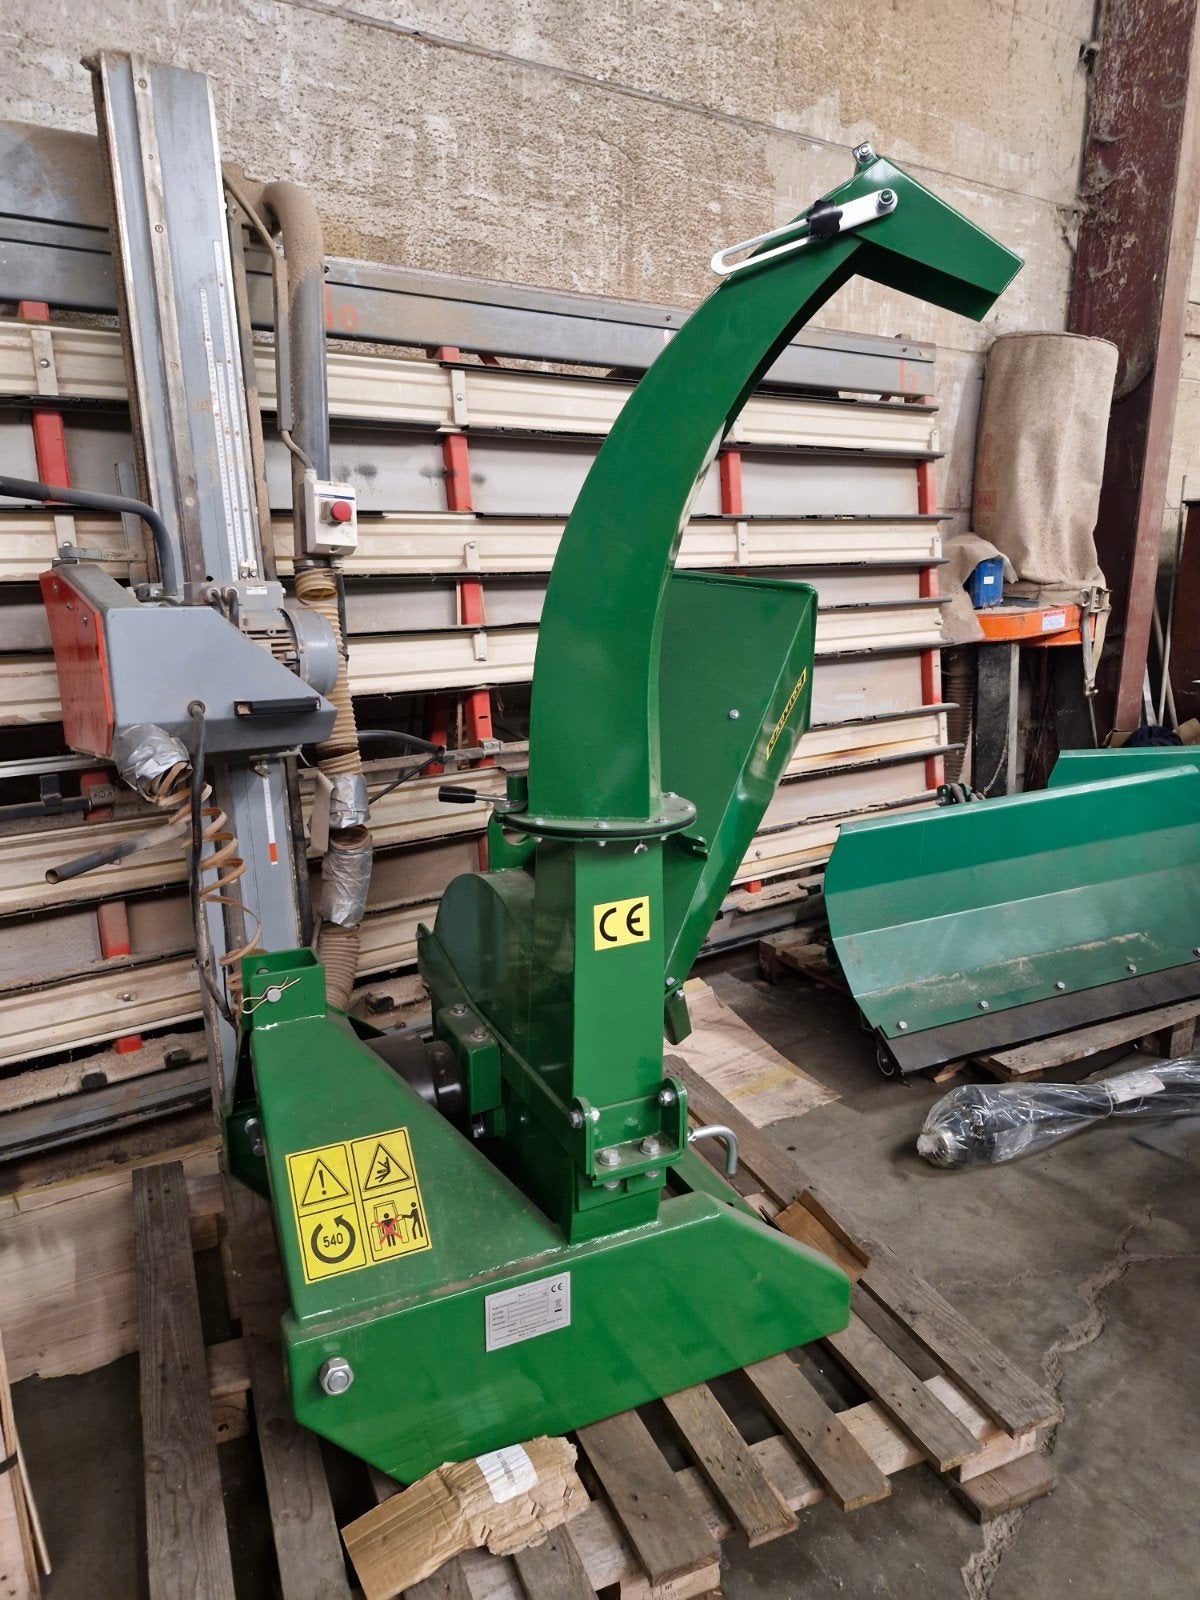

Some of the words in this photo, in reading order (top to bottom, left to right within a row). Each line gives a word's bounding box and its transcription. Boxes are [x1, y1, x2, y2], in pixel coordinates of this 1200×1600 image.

[599, 902, 644, 942] CE
[323, 1232, 344, 1248] 540
[551, 1282, 563, 1293] CE
